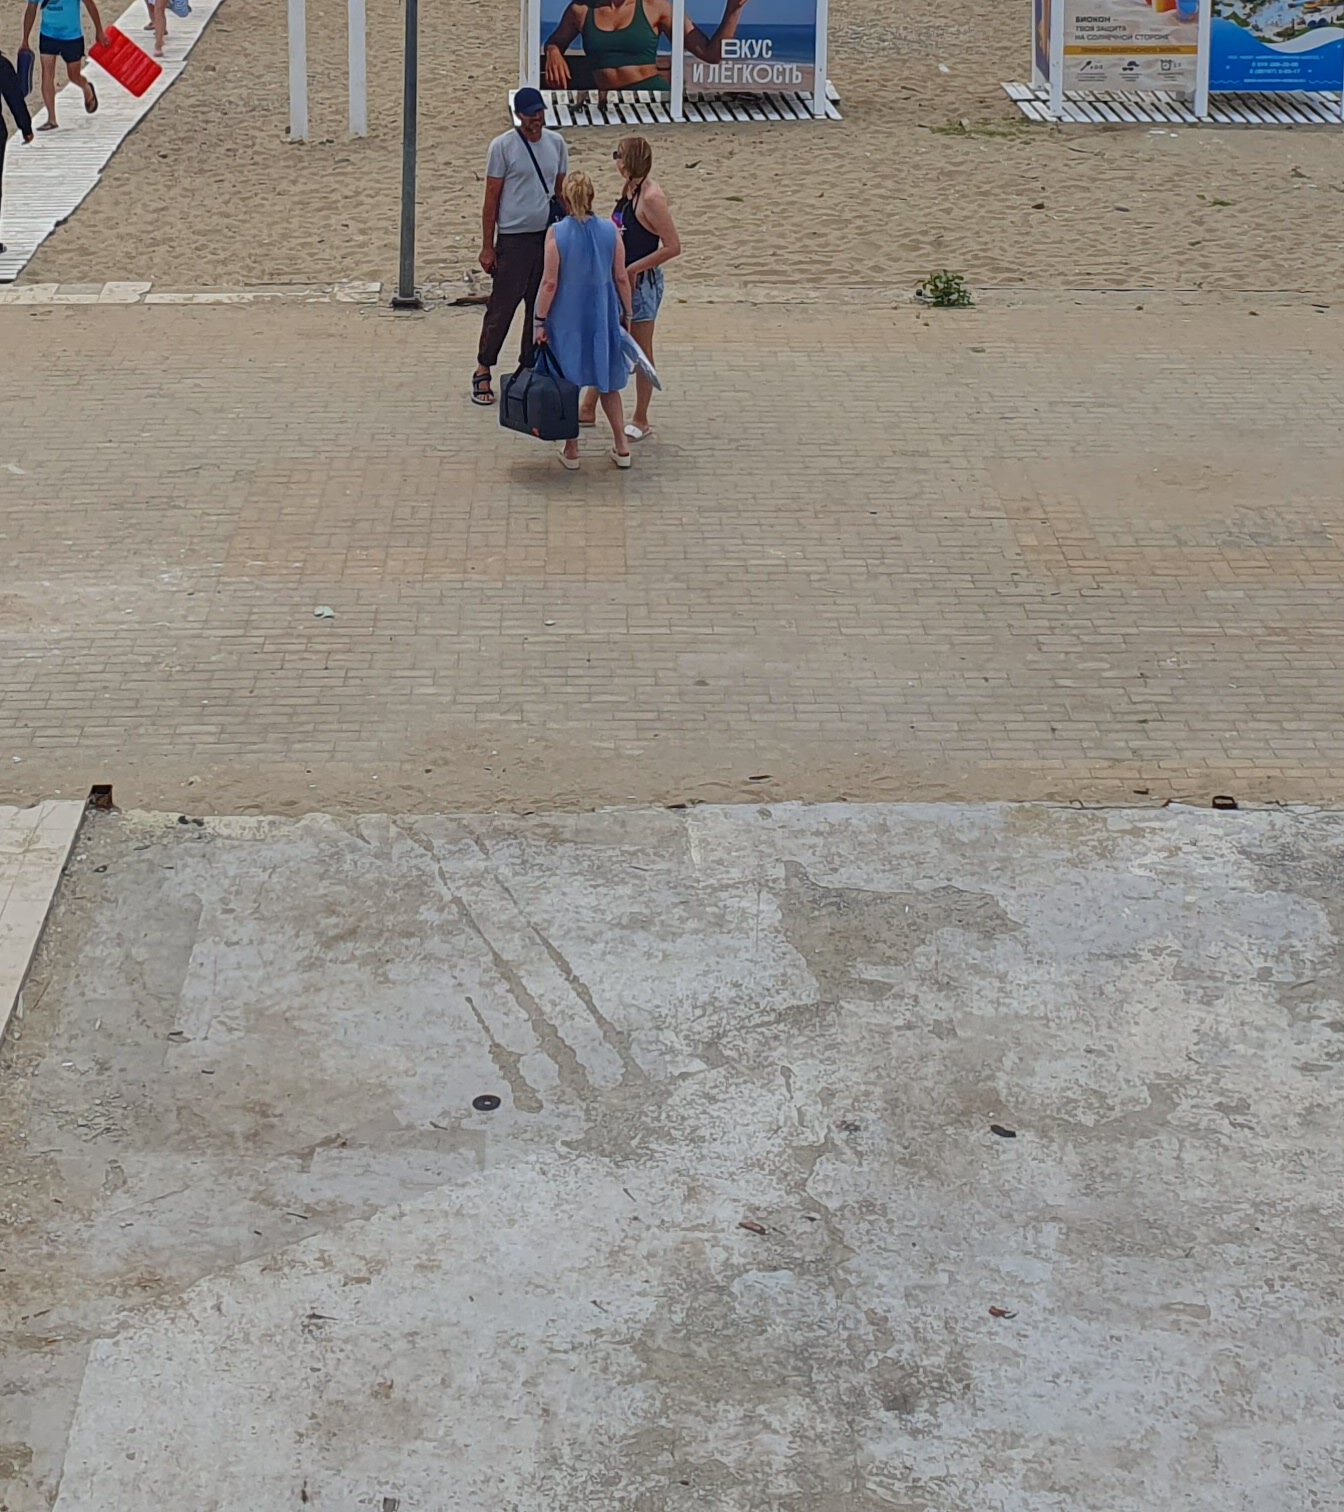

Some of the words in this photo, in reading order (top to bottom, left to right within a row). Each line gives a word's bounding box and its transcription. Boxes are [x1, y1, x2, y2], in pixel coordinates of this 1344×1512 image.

[721, 39, 773, 59] ВКУС
[693, 63, 704, 83] И
[708, 60, 802, 84] ЛЁГКОСТЬ
